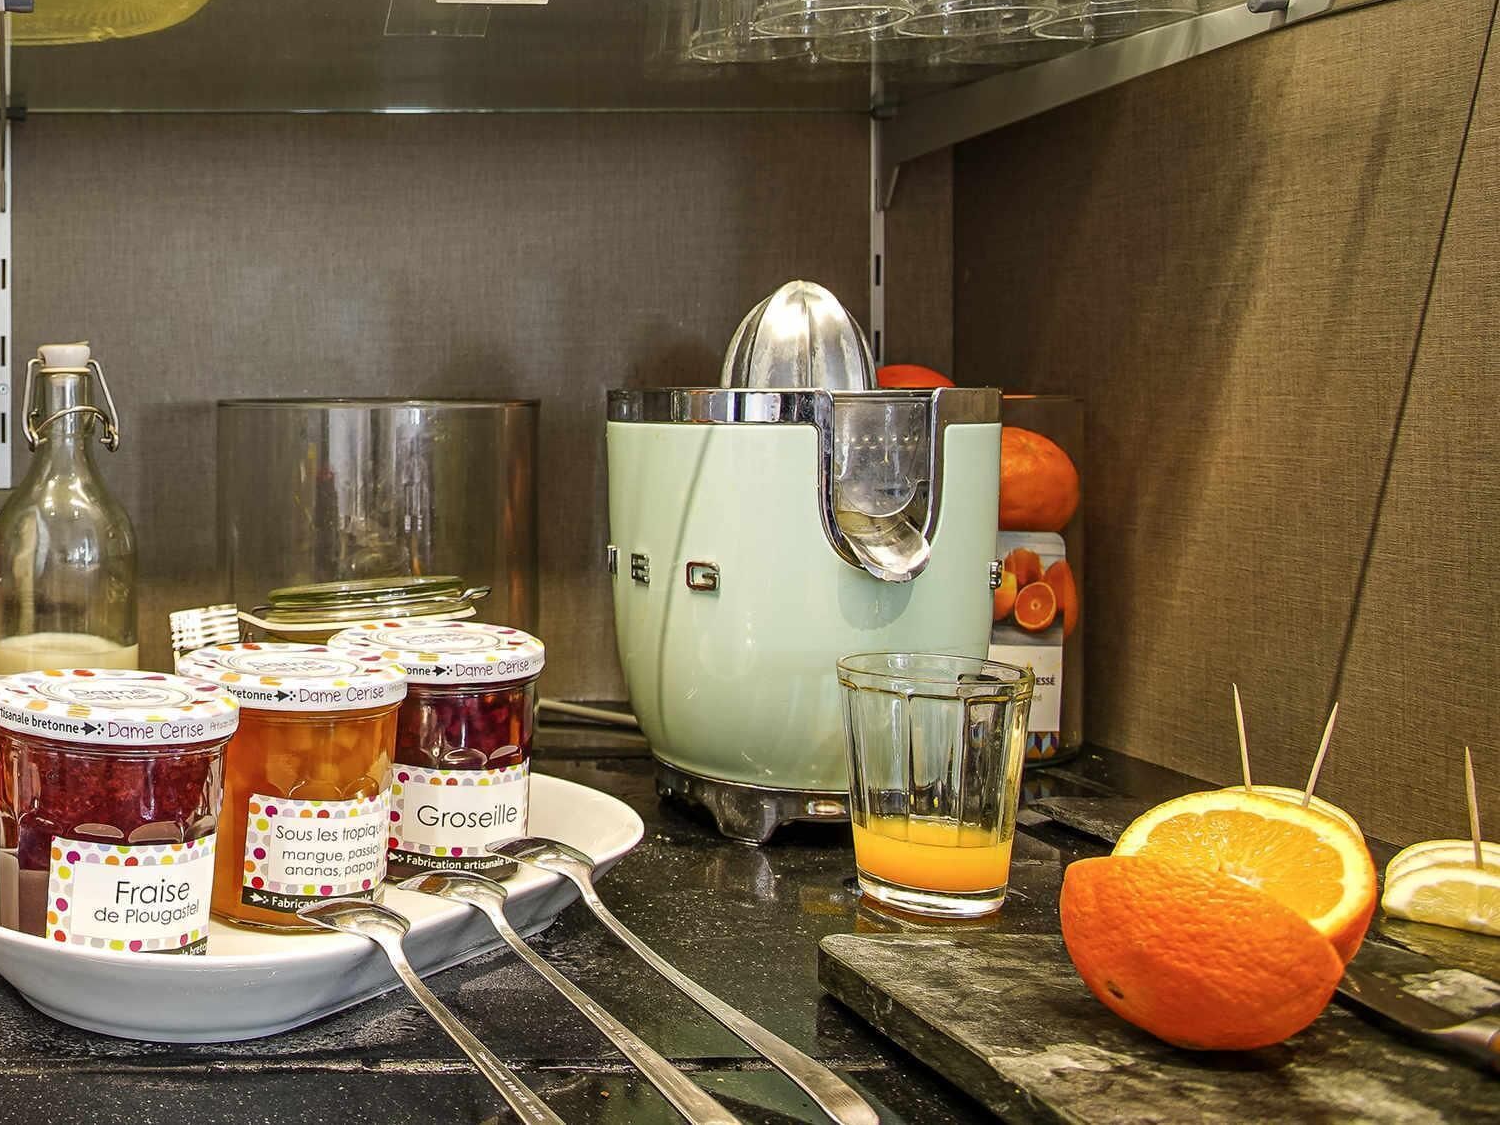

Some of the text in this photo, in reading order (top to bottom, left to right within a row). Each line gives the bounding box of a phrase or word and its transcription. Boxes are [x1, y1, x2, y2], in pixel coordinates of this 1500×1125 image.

[455, 663, 493, 677] Dame
[499, 661, 530, 675] Cerise
[299, 688, 341, 703] Dame
[346, 686, 385, 702] Cerise
[31, 715, 79, 733] bretonne
[108, 721, 154, 739] Dame
[159, 722, 204, 739] Cerise
[417, 804, 518, 828] Groseille
[275, 825, 313, 841] Sous
[317, 828, 339, 842] les
[282, 849, 346, 864] mangue,
[406, 855, 462, 870] Fabrication
[463, 857, 504, 870] artisanale
[285, 864, 342, 878] ananas,
[115, 879, 190, 905] Fraise
[94, 899, 200, 926] de Plougastel
